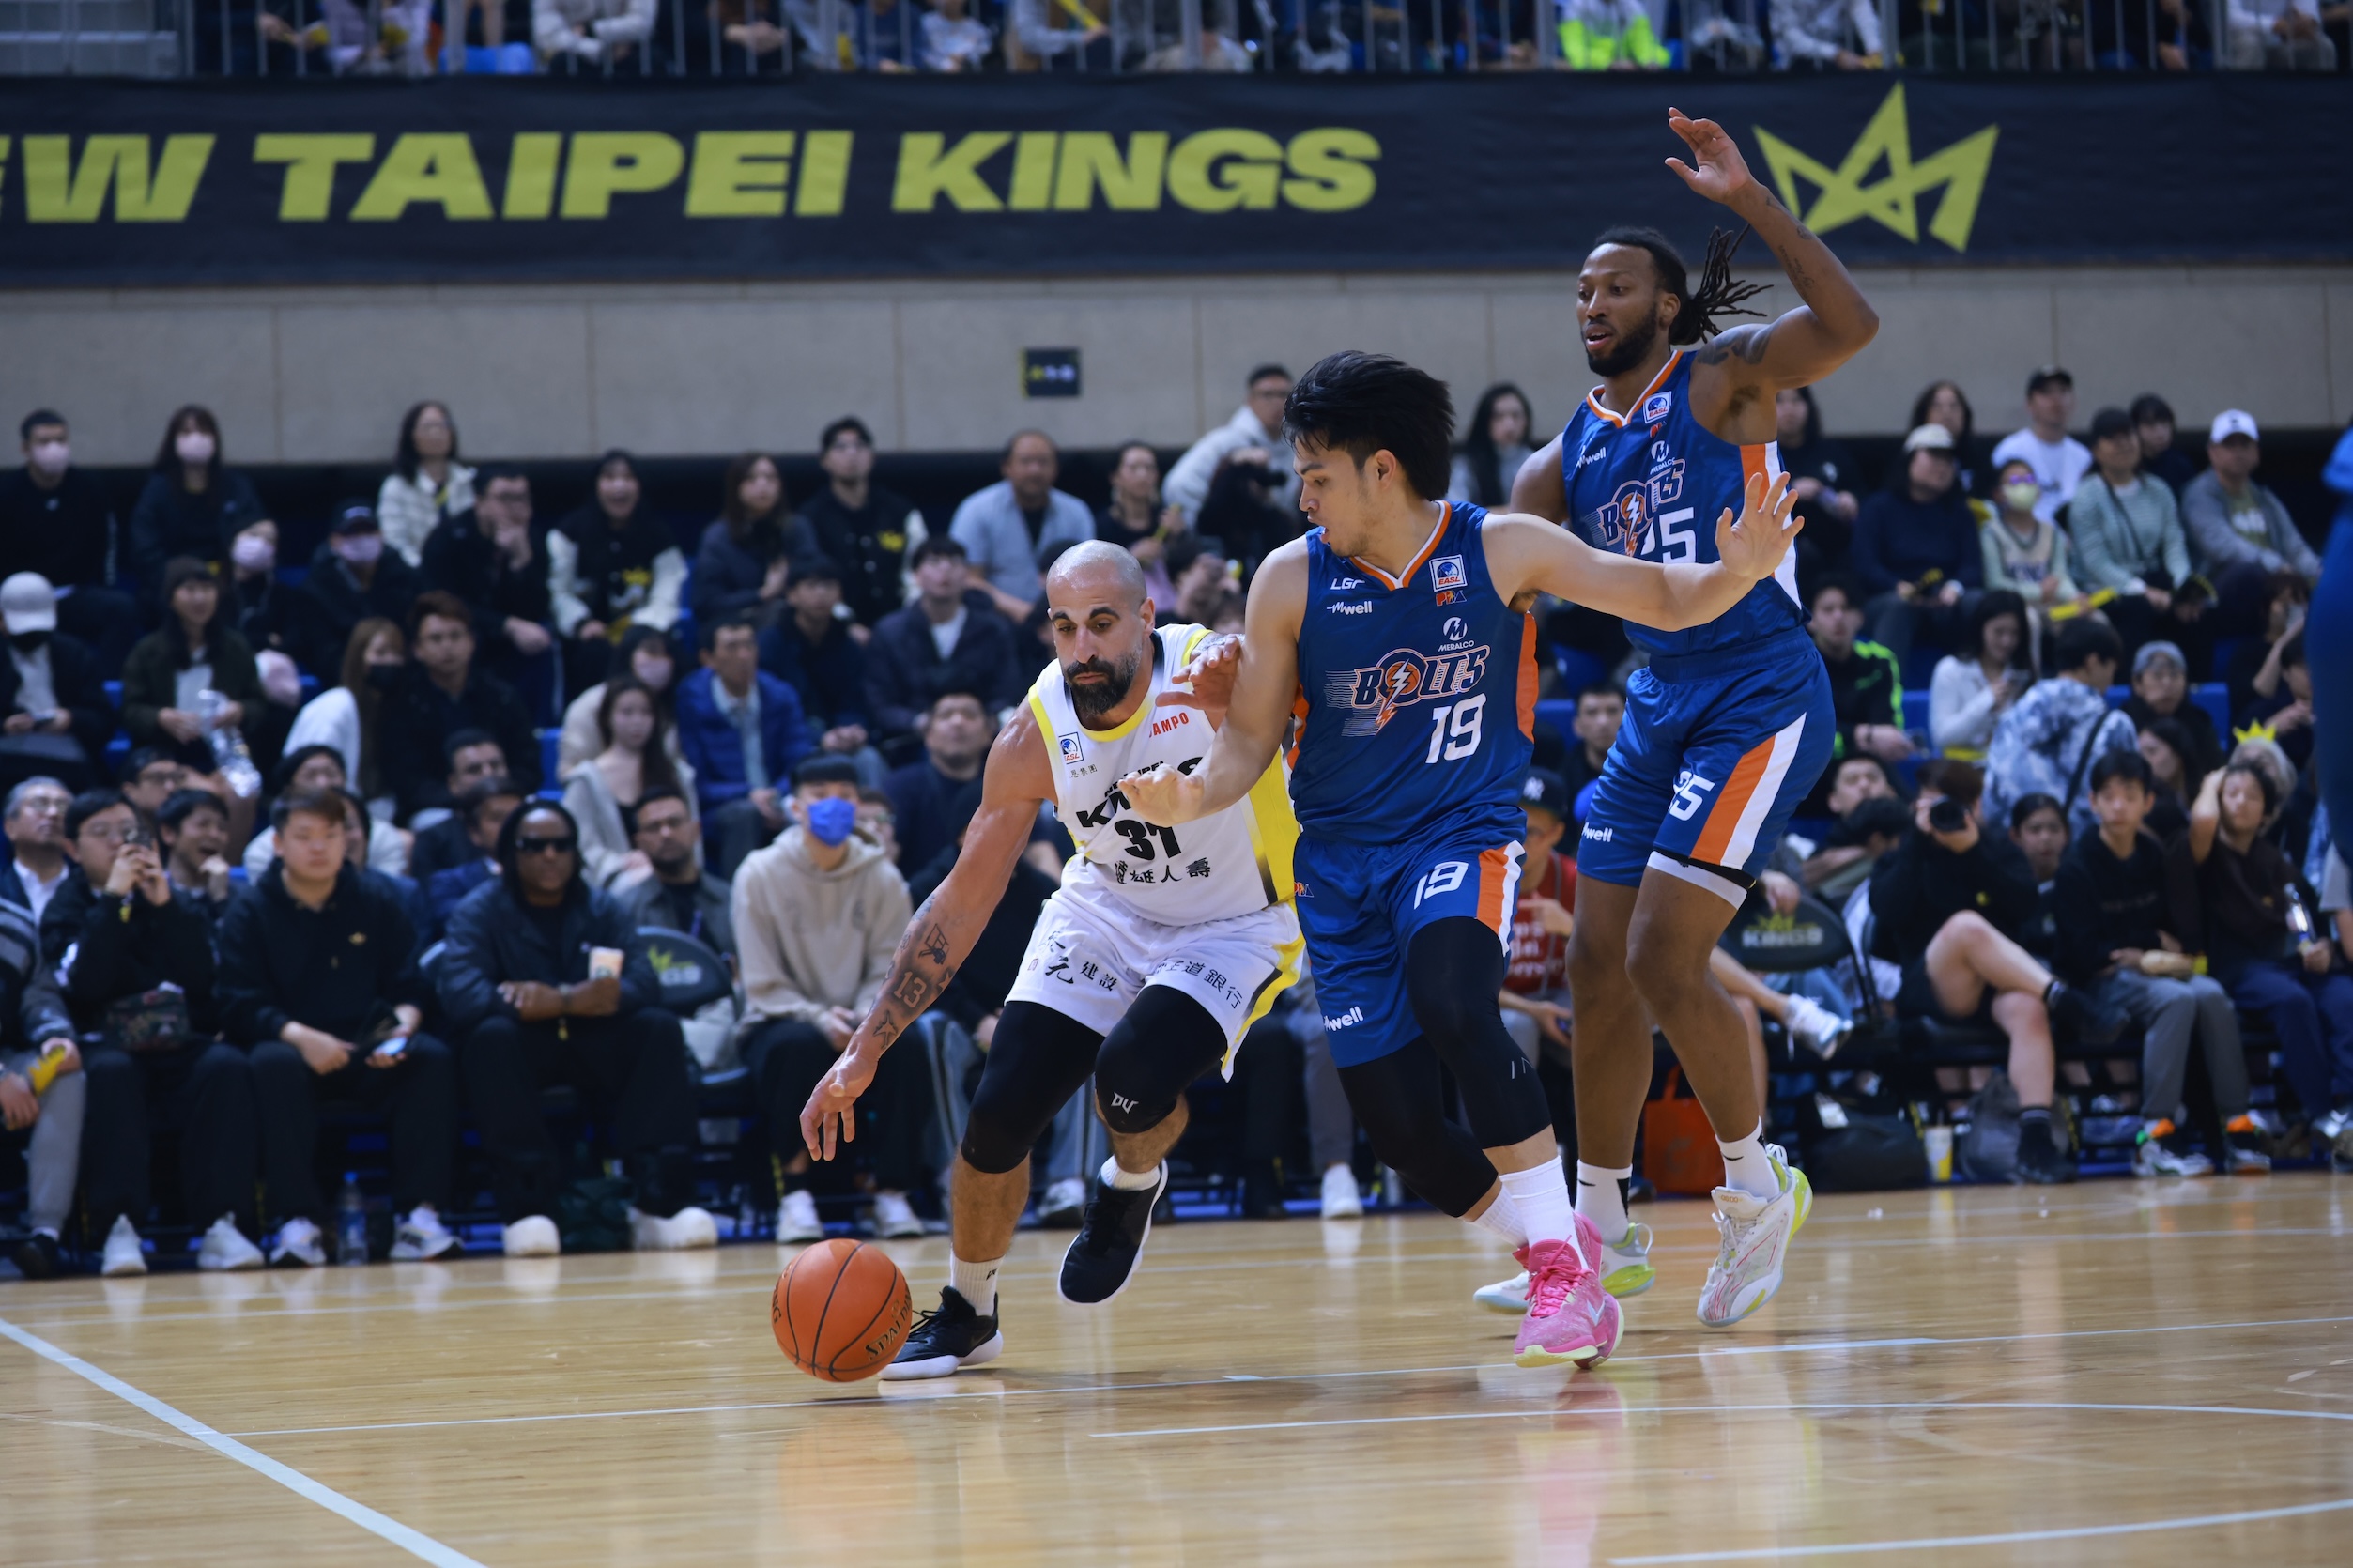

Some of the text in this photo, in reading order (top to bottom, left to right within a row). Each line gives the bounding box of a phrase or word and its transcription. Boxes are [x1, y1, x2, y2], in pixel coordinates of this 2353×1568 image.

[0, 127, 1382, 223] W TAIPEI KINGS
[1438, 576, 1461, 586] EASL
[1438, 639, 1475, 653] MERALCO
[1350, 645, 1491, 710] BOLTS
[1148, 712, 1190, 739] AMPO
[1424, 693, 1487, 764] 19
[1114, 819, 1182, 861] 31
[1413, 860, 1469, 911] 19
[893, 970, 927, 1009] 13
